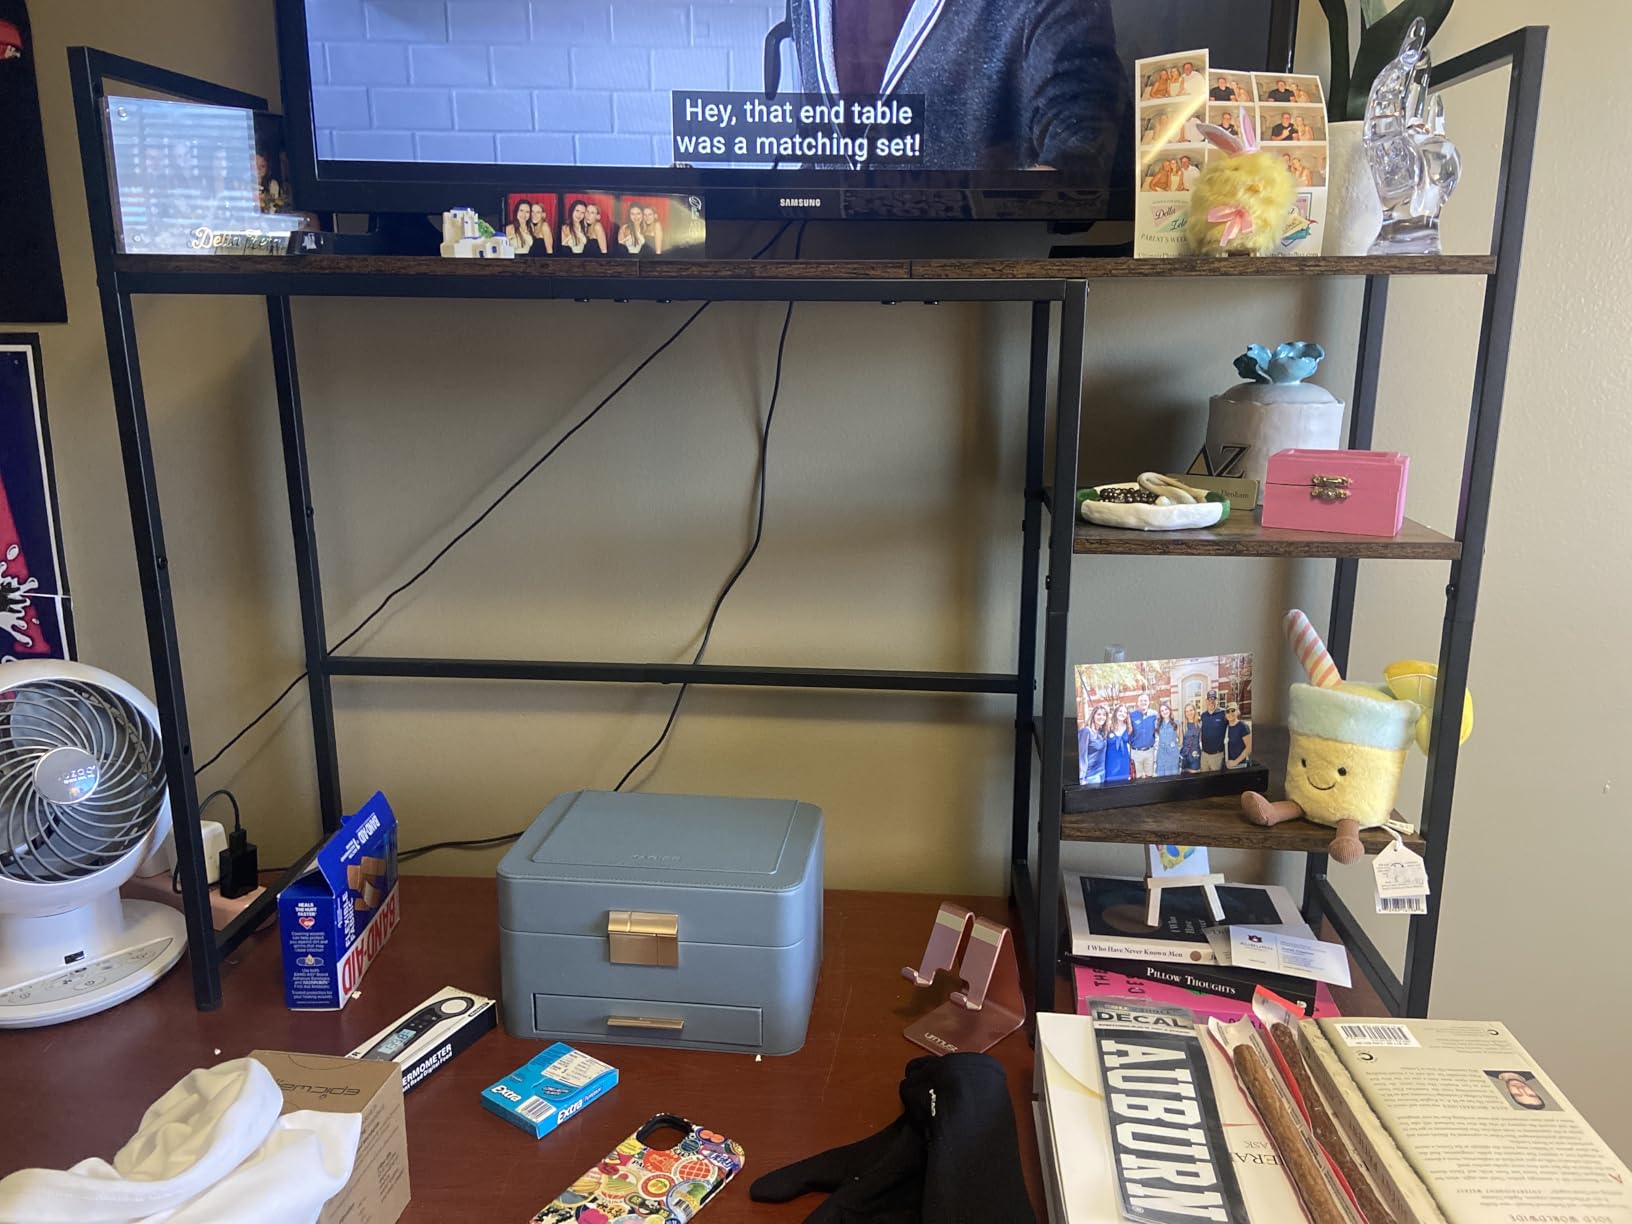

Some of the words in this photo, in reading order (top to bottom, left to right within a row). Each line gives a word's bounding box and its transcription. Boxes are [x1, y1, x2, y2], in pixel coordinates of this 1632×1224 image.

[685, 98, 736, 127] Hey,
[744, 98, 793, 123] that
[800, 99, 845, 124] end
[851, 100, 913, 125] table
[676, 135, 726, 154] was
[734, 135, 748, 154] a
[756, 131, 868, 162] matching
[876, 133, 921, 157] set!
[780, 197, 821, 208] SAMSUNG
[342, 895, 396, 996] BAND-AID
[1124, 947, 1143, 955] Never
[1146, 967, 1182, 982] PILLOW
[1184, 975, 1236, 995] THOUGHTS
[1096, 1011, 1188, 1029] DECAL
[401, 1043, 452, 1086] ERMOMETER
[491, 1085, 522, 1102] Extra
[557, 1099, 583, 1125] Extra
[1101, 1040, 1228, 1223] AUBURN
